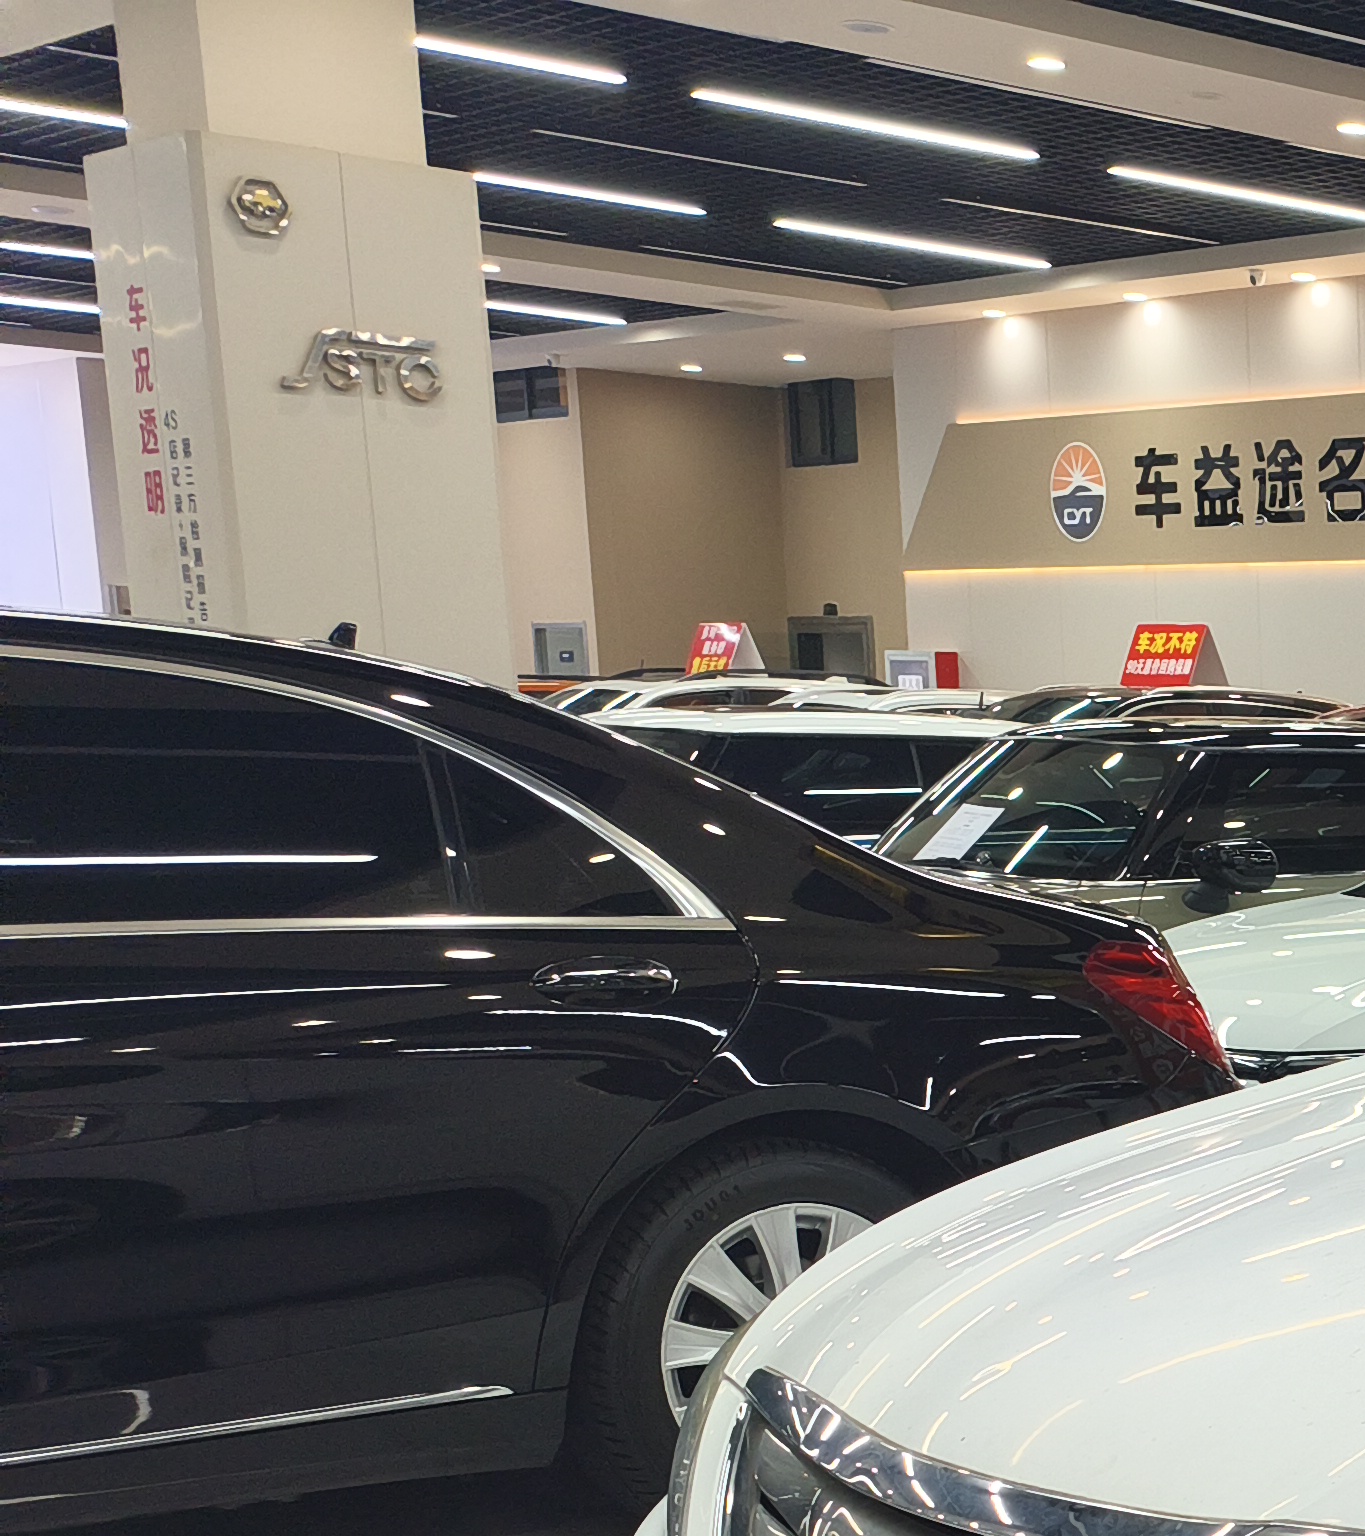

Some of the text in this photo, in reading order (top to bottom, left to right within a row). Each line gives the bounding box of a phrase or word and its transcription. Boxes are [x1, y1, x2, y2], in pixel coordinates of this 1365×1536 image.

[126, 284, 166, 515] 车况透明
[1135, 631, 1199, 655] 车况不符
